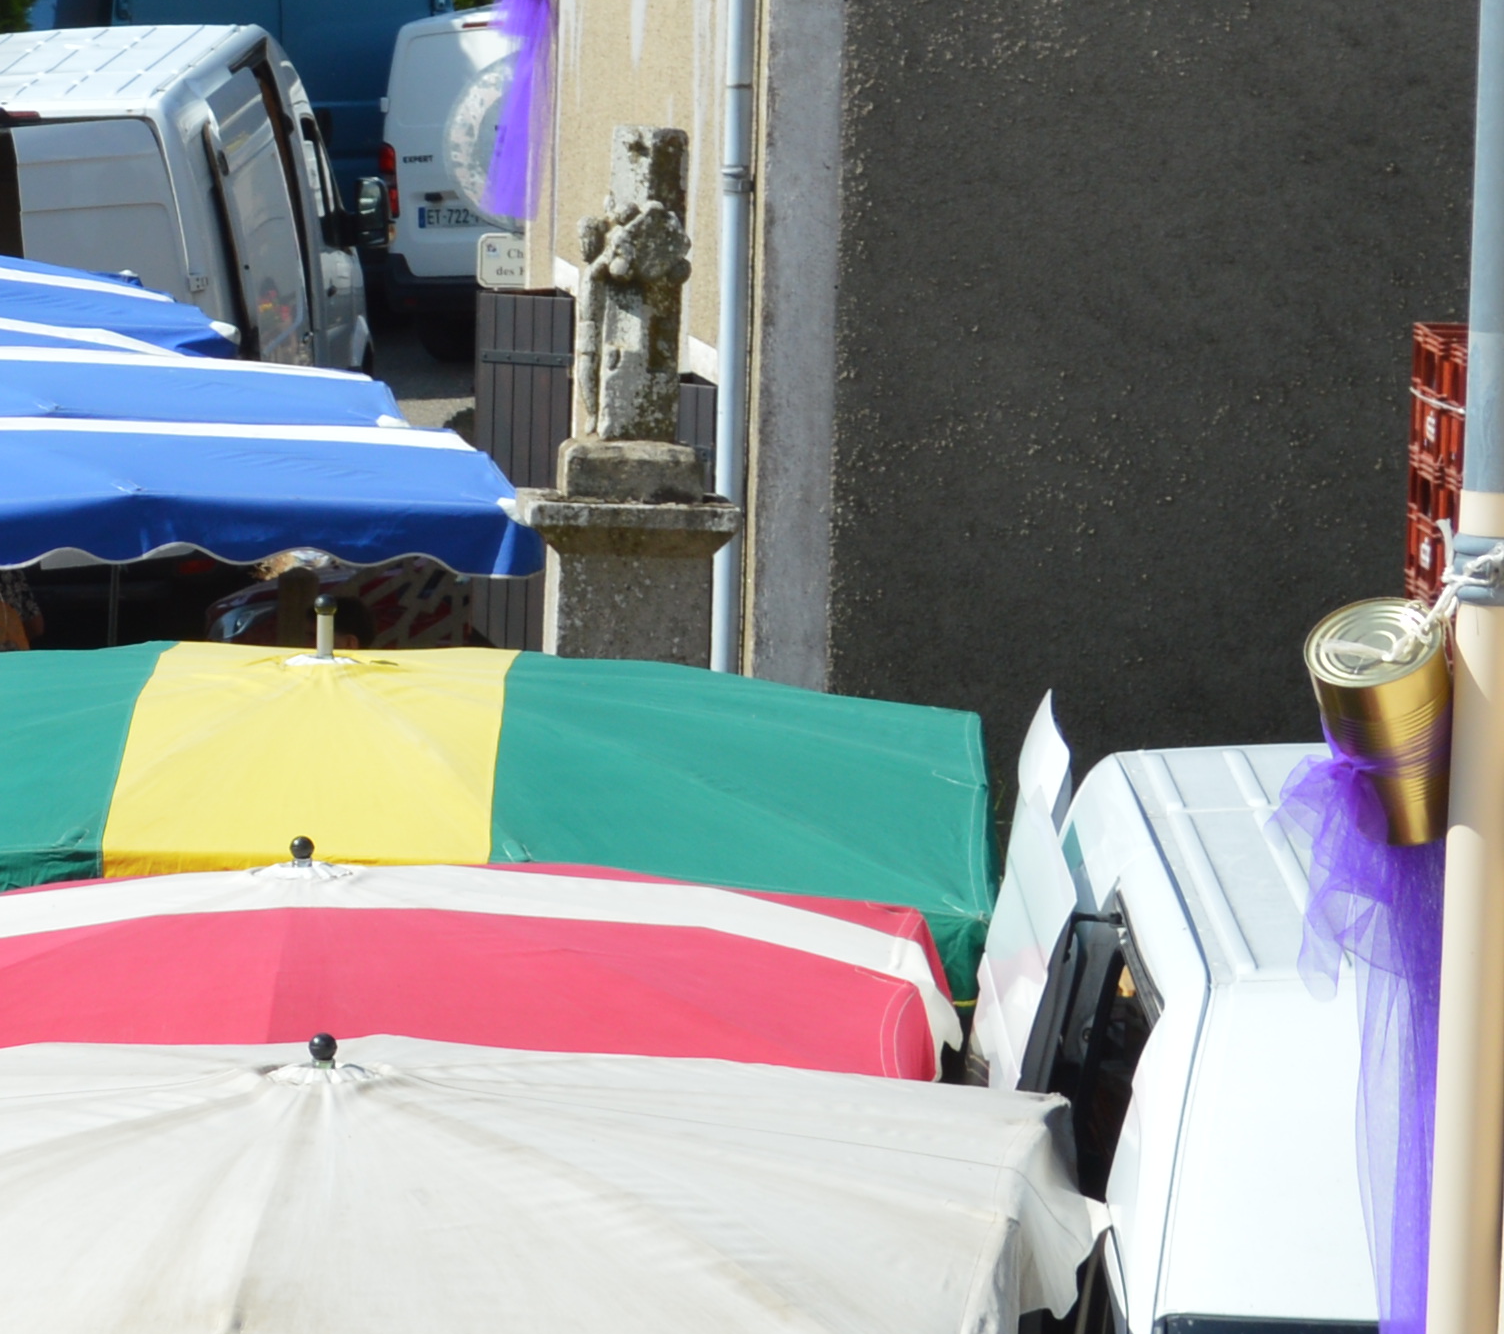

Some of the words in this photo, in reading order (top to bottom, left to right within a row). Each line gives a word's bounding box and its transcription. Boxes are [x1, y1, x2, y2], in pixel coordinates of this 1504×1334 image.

[402, 154, 434, 164] EXPERT
[426, 206, 480, 225] ET-722-
[496, 265, 515, 276] des
